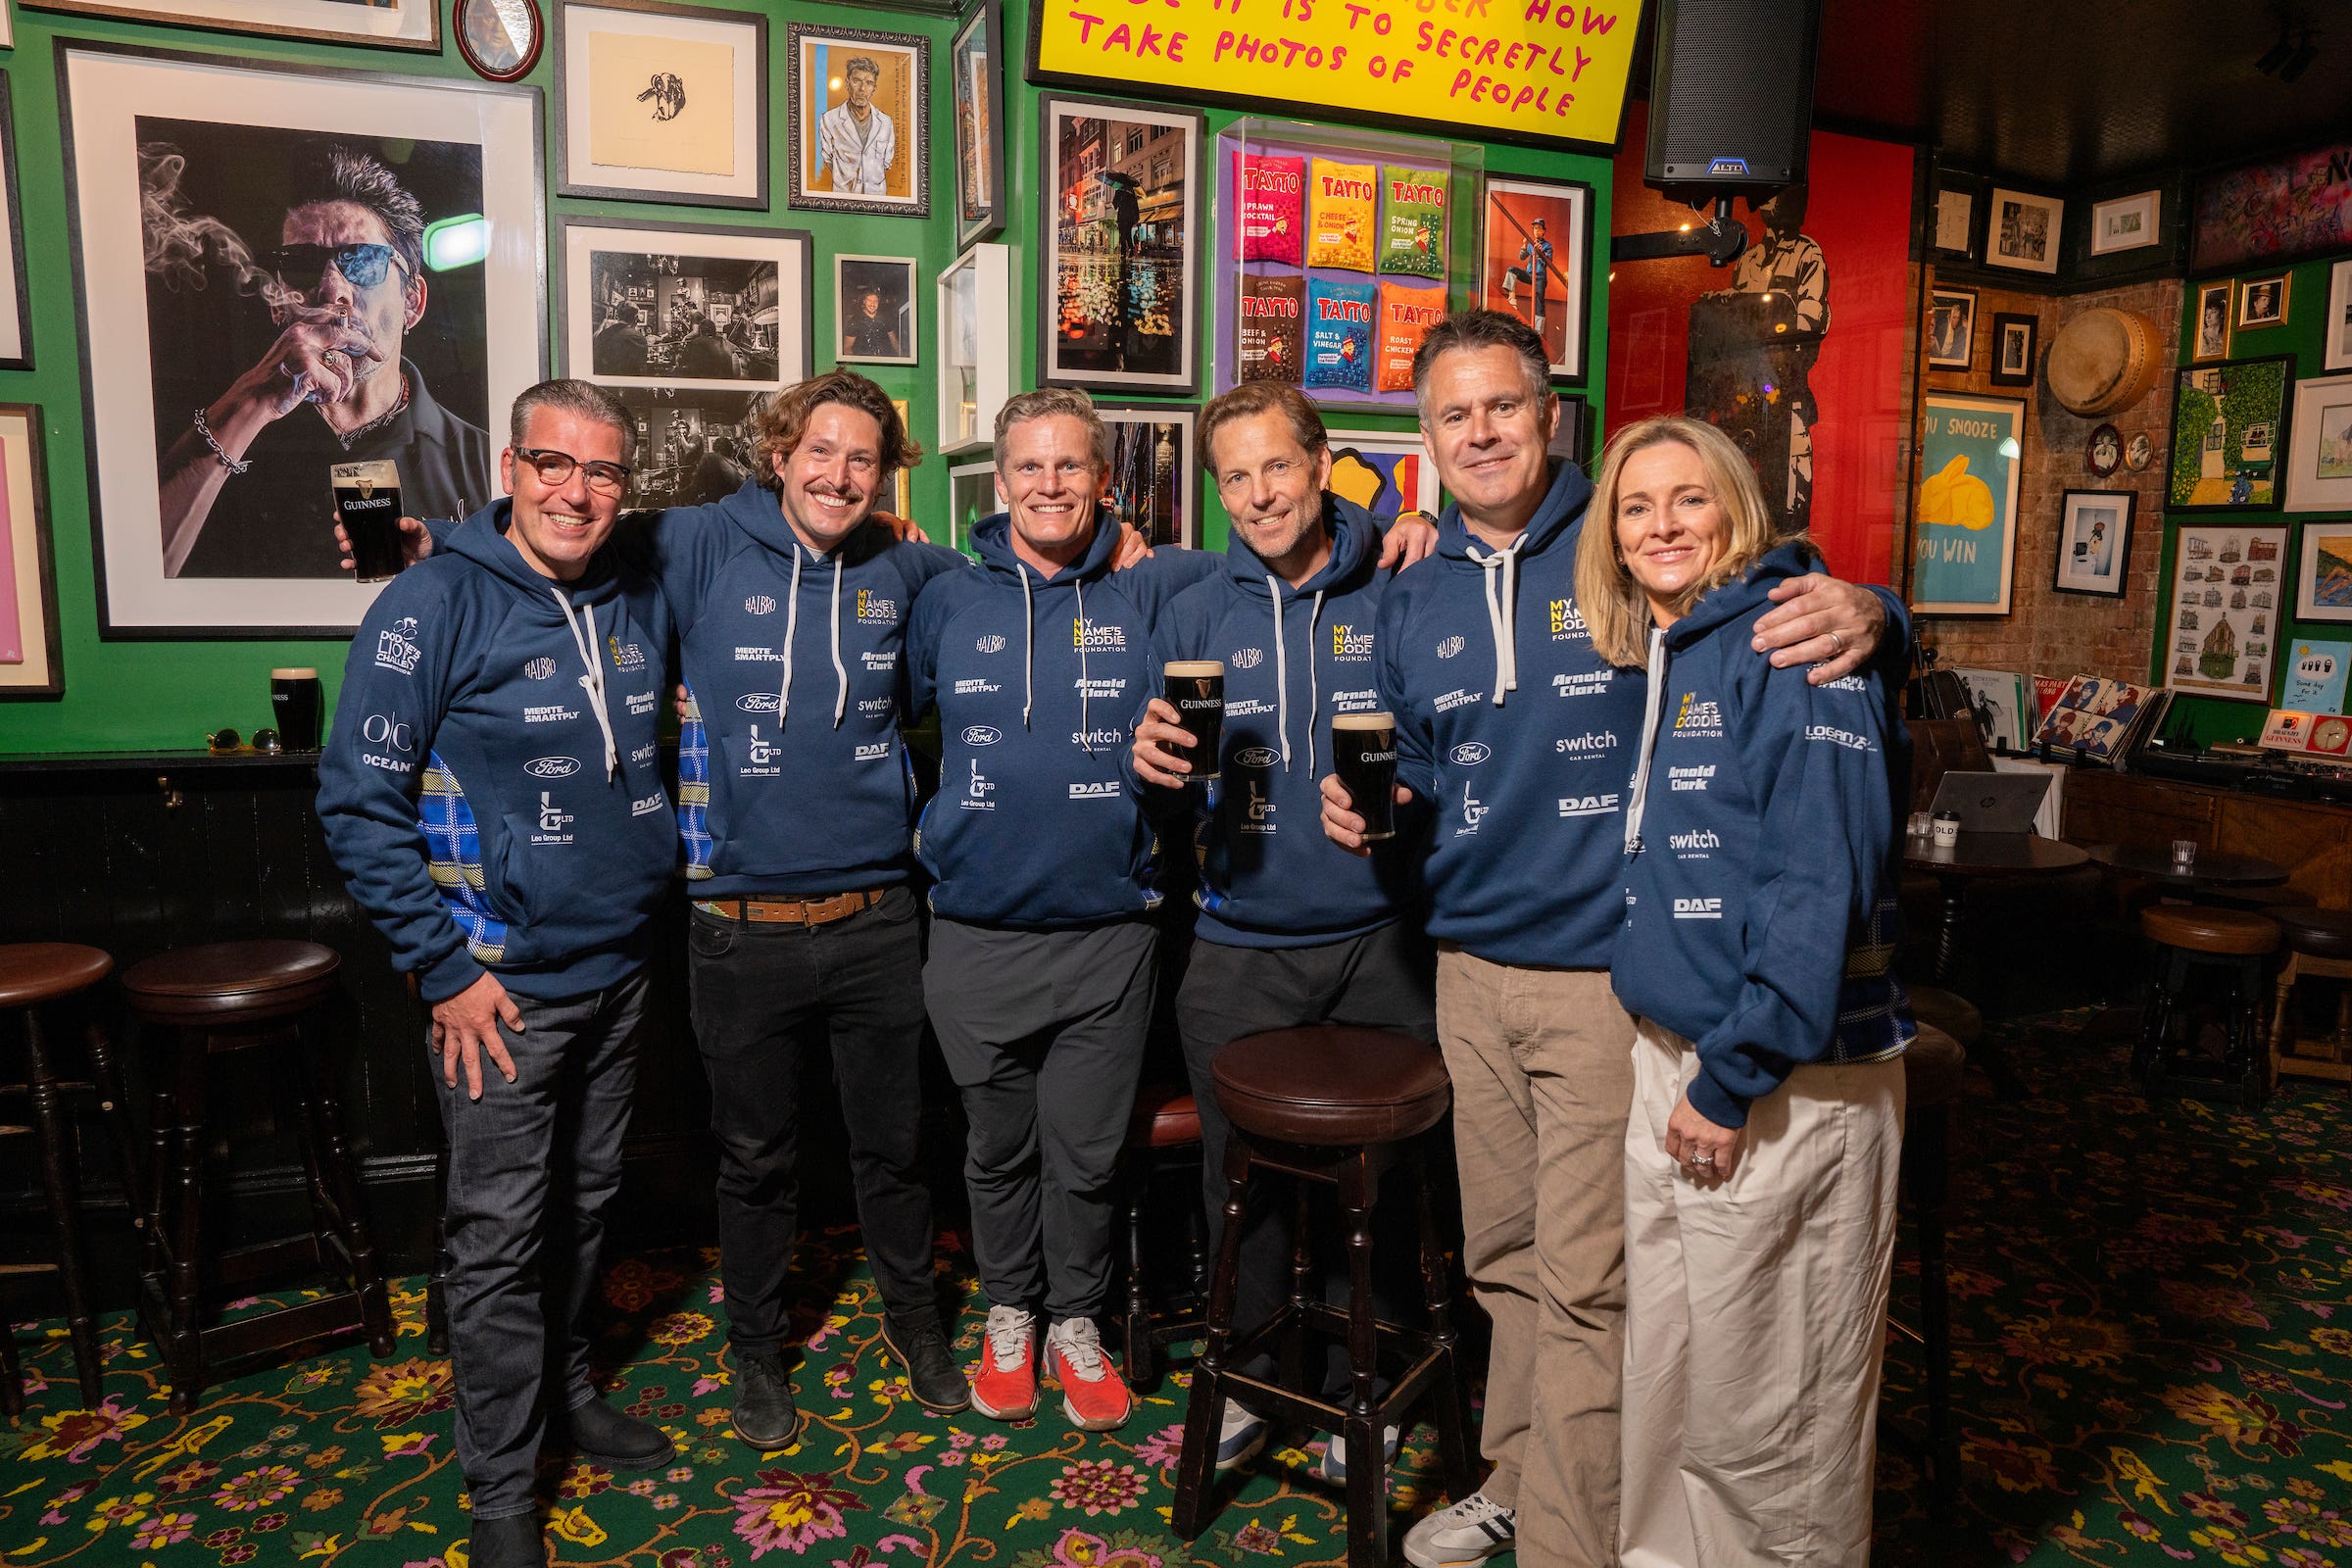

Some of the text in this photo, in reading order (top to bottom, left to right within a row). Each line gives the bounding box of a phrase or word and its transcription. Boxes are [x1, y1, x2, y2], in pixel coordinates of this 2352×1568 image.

[1525, 0, 1617, 35] HOW
[1345, 3, 1392, 35] TO
[1416, 21, 1592, 82] SECRETLY
[1069, 11, 1575, 117] TAKE PHOTOS OF PEOPLE
[1244, 168, 1299, 194] TAYTO
[1321, 175, 1373, 203] TAYTO
[1392, 181, 1444, 208] TAYTO
[1319, 213, 1347, 221] CHEESE
[1391, 216, 1417, 226] SPRING
[1391, 224, 1414, 234] ONION
[1243, 296, 1298, 318] TAYTO
[1317, 297, 1371, 322] TAYTO
[1391, 304, 1443, 326] TAYTO
[1313, 340, 1342, 350] VINEGAR
[1385, 345, 1414, 354] CHICKEN
[1947, 418, 1997, 439] SNOOZE
[344, 498, 391, 510] GUINNESS
[1943, 538, 1977, 564] WIN
[858, 588, 873, 599] MY
[745, 595, 776, 615] HALBRO
[1549, 598, 1572, 612] MY
[858, 608, 898, 618] DODDIE
[1334, 624, 1352, 635] MY
[1552, 631, 1592, 641] FOUNDA
[976, 635, 1006, 654] HALBRO
[1074, 636, 1126, 646] DODDIE
[1437, 635, 1464, 659] HALBRO
[861, 652, 896, 662] Arnold
[1232, 648, 1263, 669] HALBRO
[524, 658, 556, 680] HALBRO
[866, 661, 894, 670] Clark
[955, 678, 986, 687] MEDITE
[1074, 679, 1126, 688] Arnold
[1551, 670, 1613, 687] Arnold
[955, 683, 1001, 694] SMARTPLY
[1559, 683, 1607, 698] Clark
[626, 691, 655, 706] Arnold
[745, 696, 779, 710] Ford
[858, 696, 892, 711] switch
[1180, 699, 1222, 710] GUINNESS
[1225, 699, 1259, 710] MEDITE
[1434, 689, 1465, 706] MEDITE
[1435, 692, 1483, 713] SMARTPLY
[1683, 691, 1696, 705] MY
[523, 705, 564, 715] MEDITE
[631, 702, 654, 714] Clark
[1225, 705, 1275, 717] SMARTPLY
[1338, 700, 1378, 710] Clark
[523, 711, 579, 723] SMARTPLY
[1675, 714, 1722, 728] DODDIE
[966, 729, 993, 743] Ford
[1072, 728, 1122, 744] switch
[1805, 725, 1853, 743] LOGAN
[1555, 730, 1617, 753] switch
[856, 743, 889, 756] DAF
[1457, 746, 1482, 761] Ford
[362, 754, 412, 772] OCEAN
[1243, 750, 1271, 764] Ford
[534, 758, 571, 776] Ford
[1668, 765, 1716, 779] Arnold
[1069, 782, 1120, 795] DAF
[1671, 778, 1708, 791] Clark
[632, 793, 662, 811] DAF
[1558, 794, 1619, 811] DAF
[562, 814, 574, 823] LTD
[1669, 829, 1720, 851] switch
[1674, 898, 1722, 911] DAF
